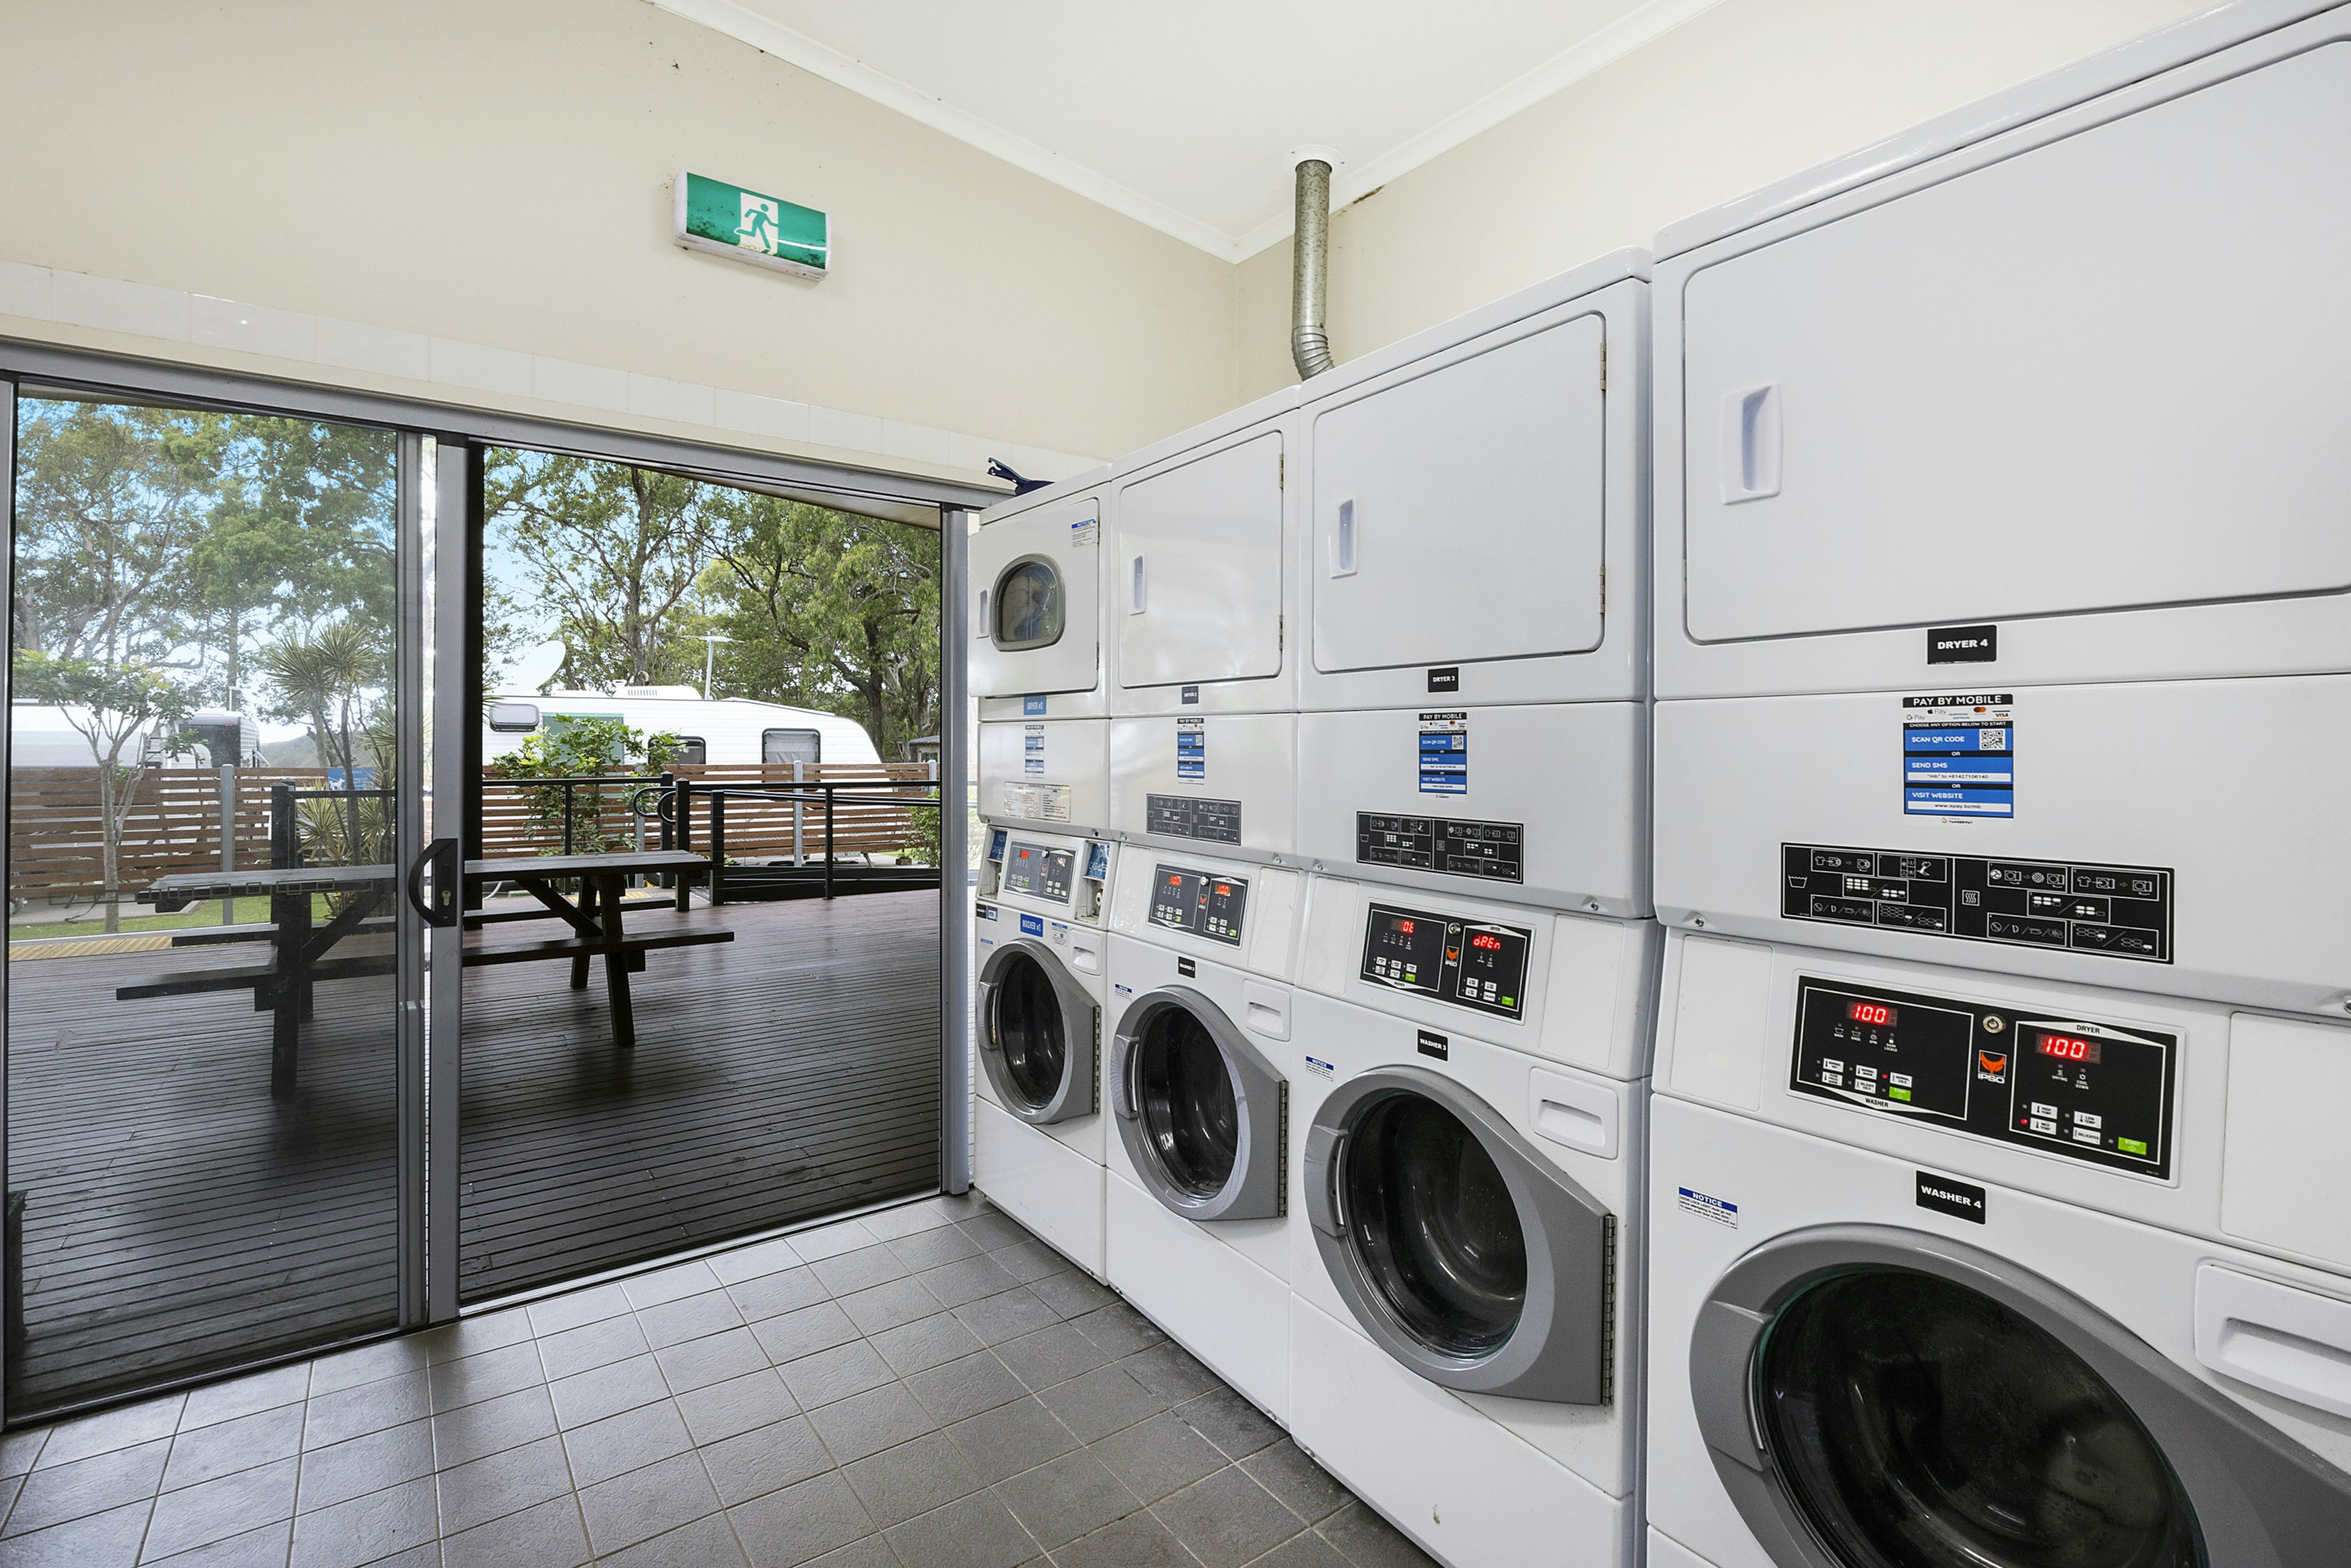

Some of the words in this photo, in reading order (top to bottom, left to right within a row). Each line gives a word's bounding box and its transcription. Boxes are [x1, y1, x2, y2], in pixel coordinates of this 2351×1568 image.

[1937, 640, 1978, 649] DRYER
[1980, 639, 1988, 647] 4
[1913, 698, 1934, 706] PAY
[1956, 695, 2002, 704] MOBILE
[1855, 1005, 1887, 1023] 100
[2077, 1025, 2100, 1034] DRYER
[1420, 1038, 1442, 1050] WASHER
[2046, 1037, 2085, 1058] 100
[1978, 1073, 2005, 1084] IPSO
[1865, 1098, 1889, 1108] WASHER
[1693, 1192, 1722, 1207] NOTICE
[1921, 1185, 1971, 1206] WASHER
